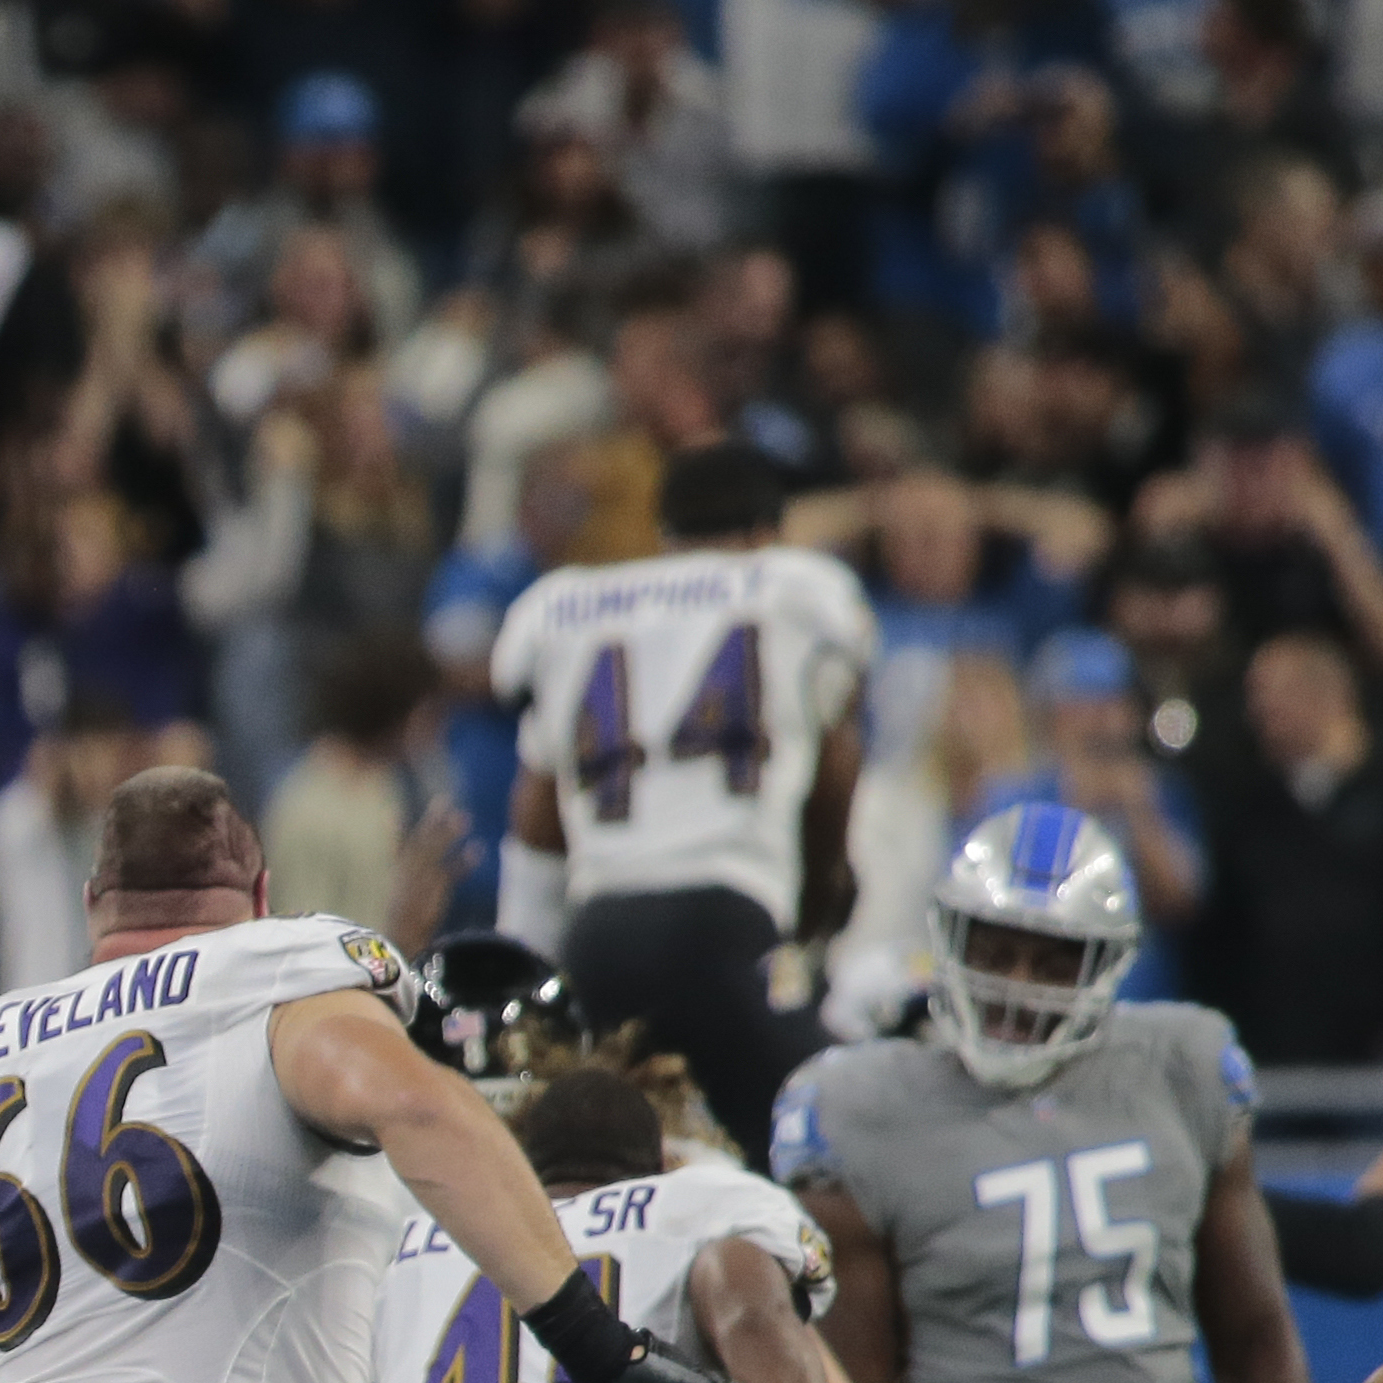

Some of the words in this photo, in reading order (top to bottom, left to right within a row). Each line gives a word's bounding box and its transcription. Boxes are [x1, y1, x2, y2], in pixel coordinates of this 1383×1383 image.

[574, 616, 771, 824] 44
[585, 1185, 655, 1238] SR
[972, 1138, 1160, 1368] 75
